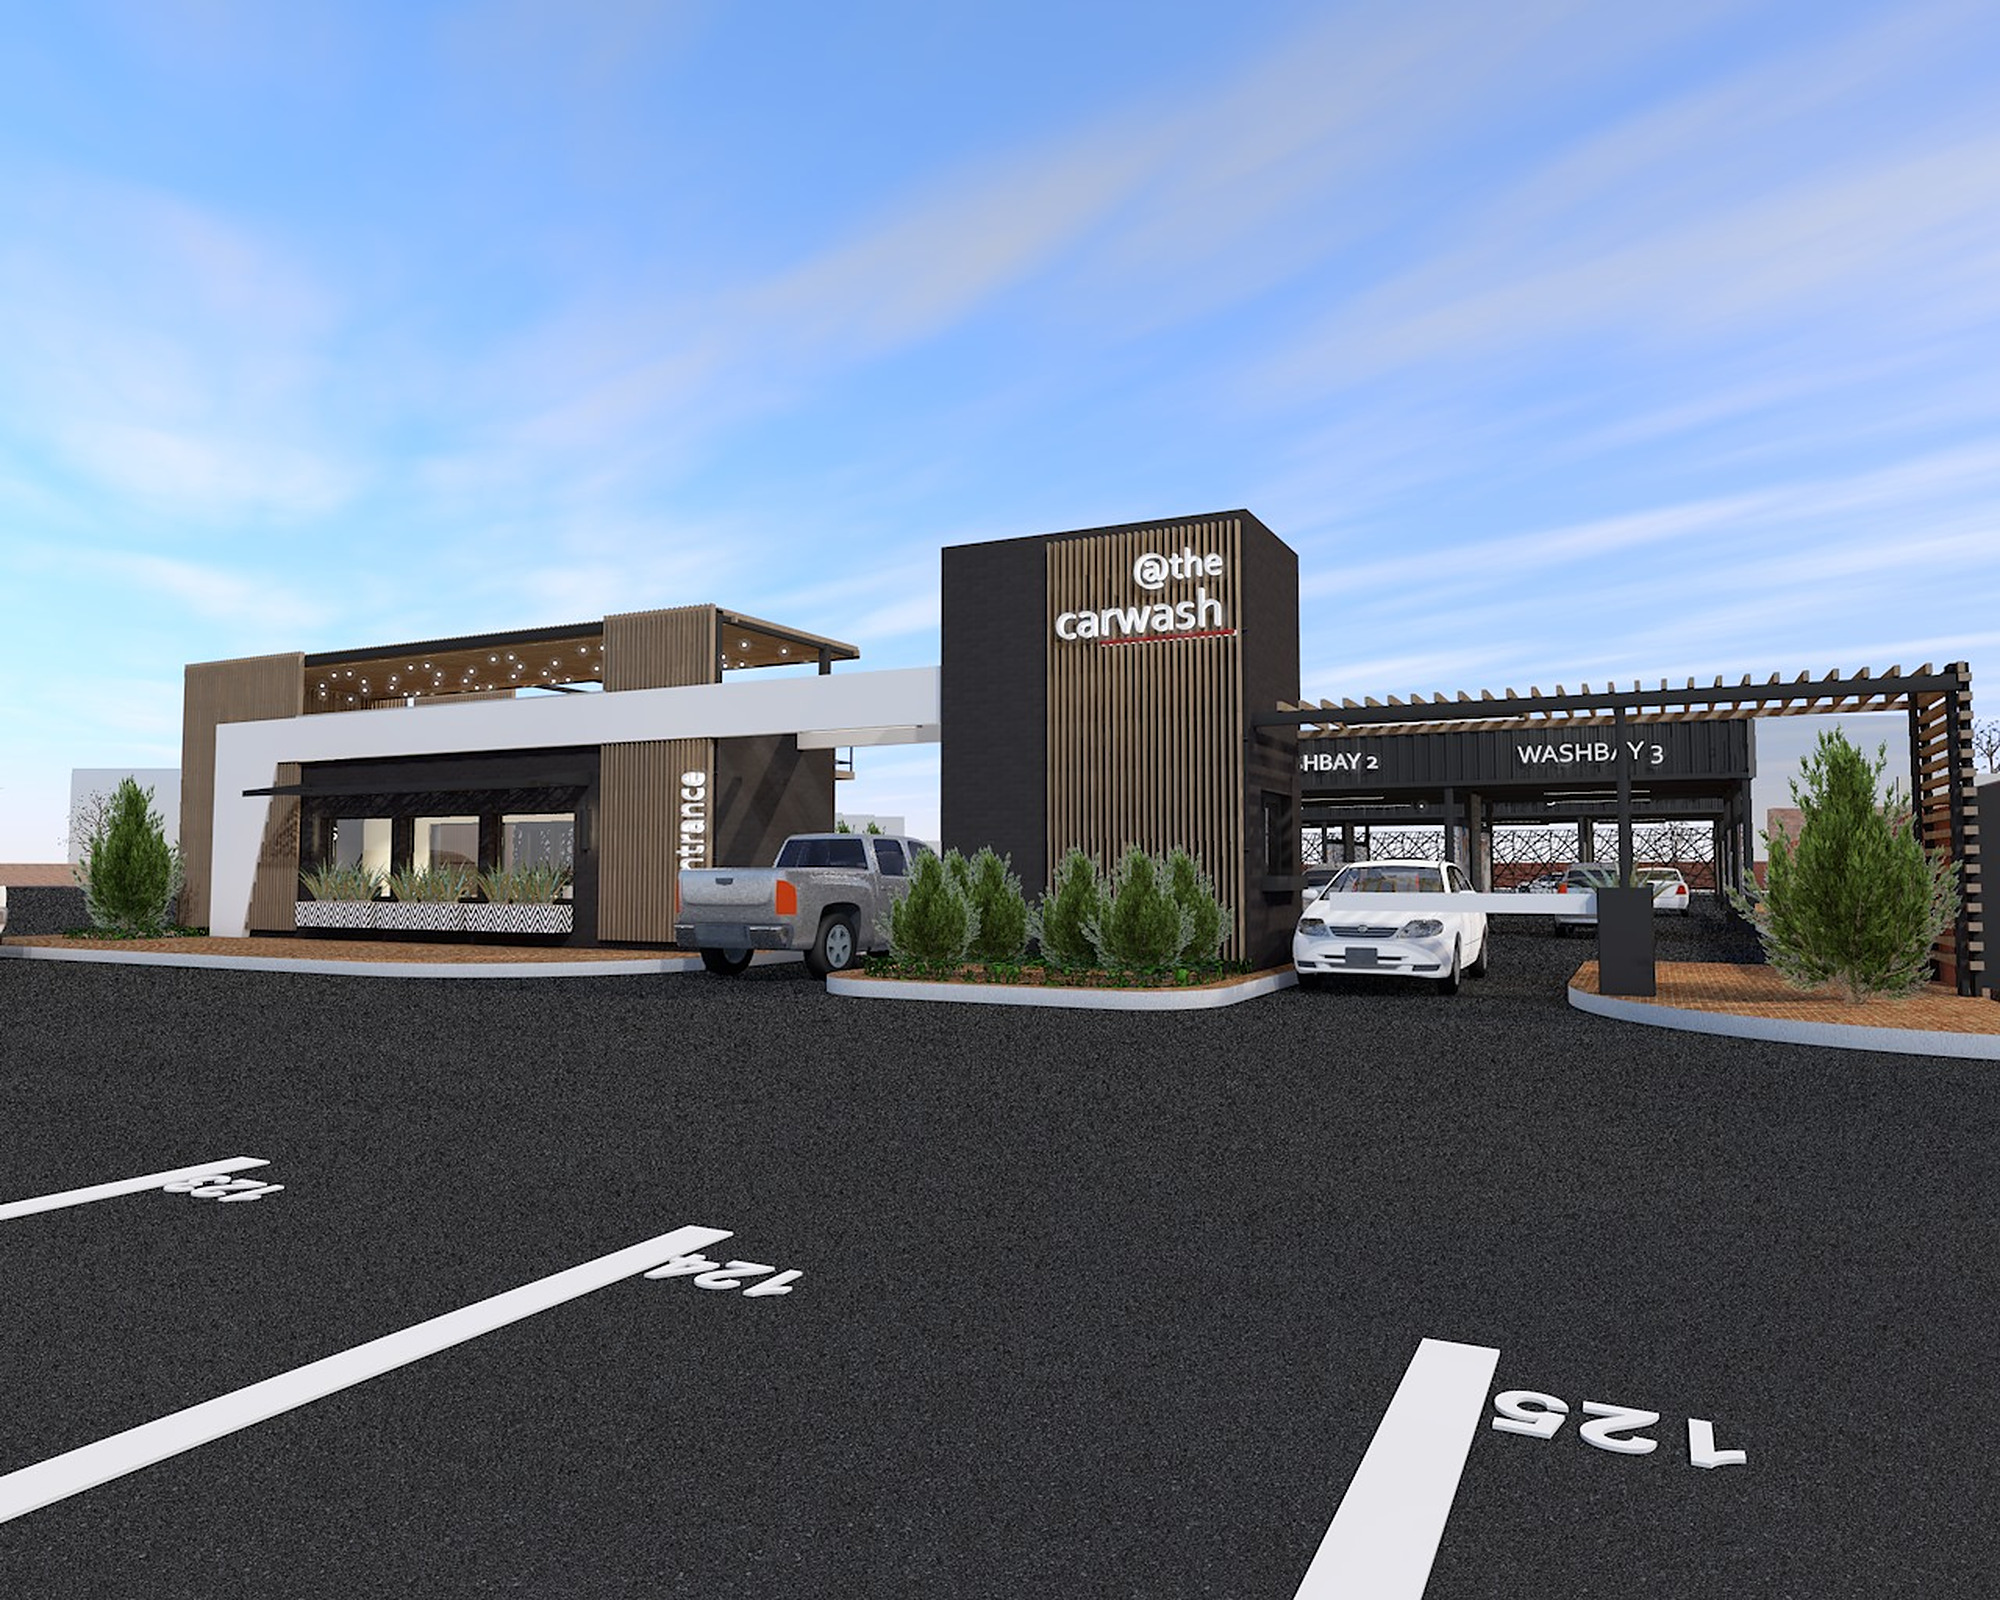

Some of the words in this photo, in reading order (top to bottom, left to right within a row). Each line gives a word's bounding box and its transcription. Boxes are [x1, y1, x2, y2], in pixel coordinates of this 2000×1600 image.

[1133, 546, 1223, 590] @the
[1055, 588, 1222, 640] carwash
[1299, 752, 1361, 772] HBAY
[1366, 755, 1379, 770] 2
[1650, 745, 1665, 765] 3
[675, 771, 706, 870] ntrance
[644, 1253, 803, 1297] 124
[1492, 1389, 1747, 1469] 125
